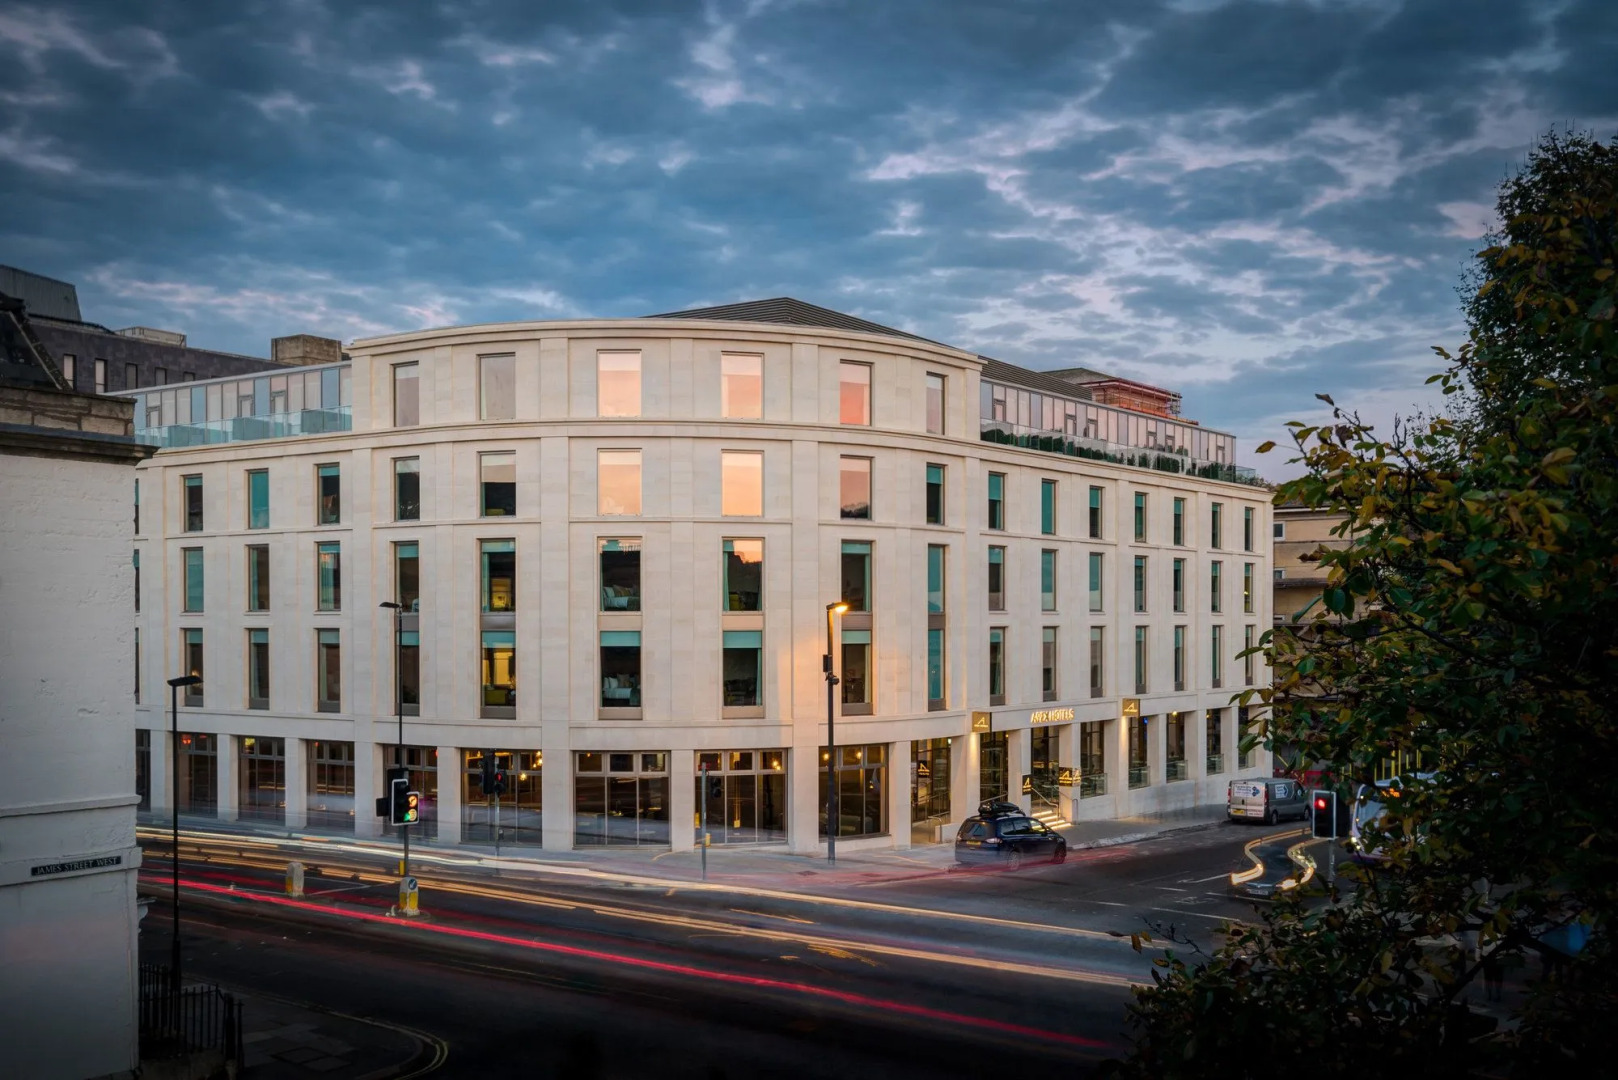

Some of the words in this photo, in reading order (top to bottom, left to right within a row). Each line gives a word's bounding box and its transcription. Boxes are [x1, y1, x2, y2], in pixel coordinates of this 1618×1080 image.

[1030, 711, 1049, 723] APEX
[35, 866, 62, 875] JAMES
[64, 860, 93, 872] STREET
[96, 857, 117, 867] WEST
